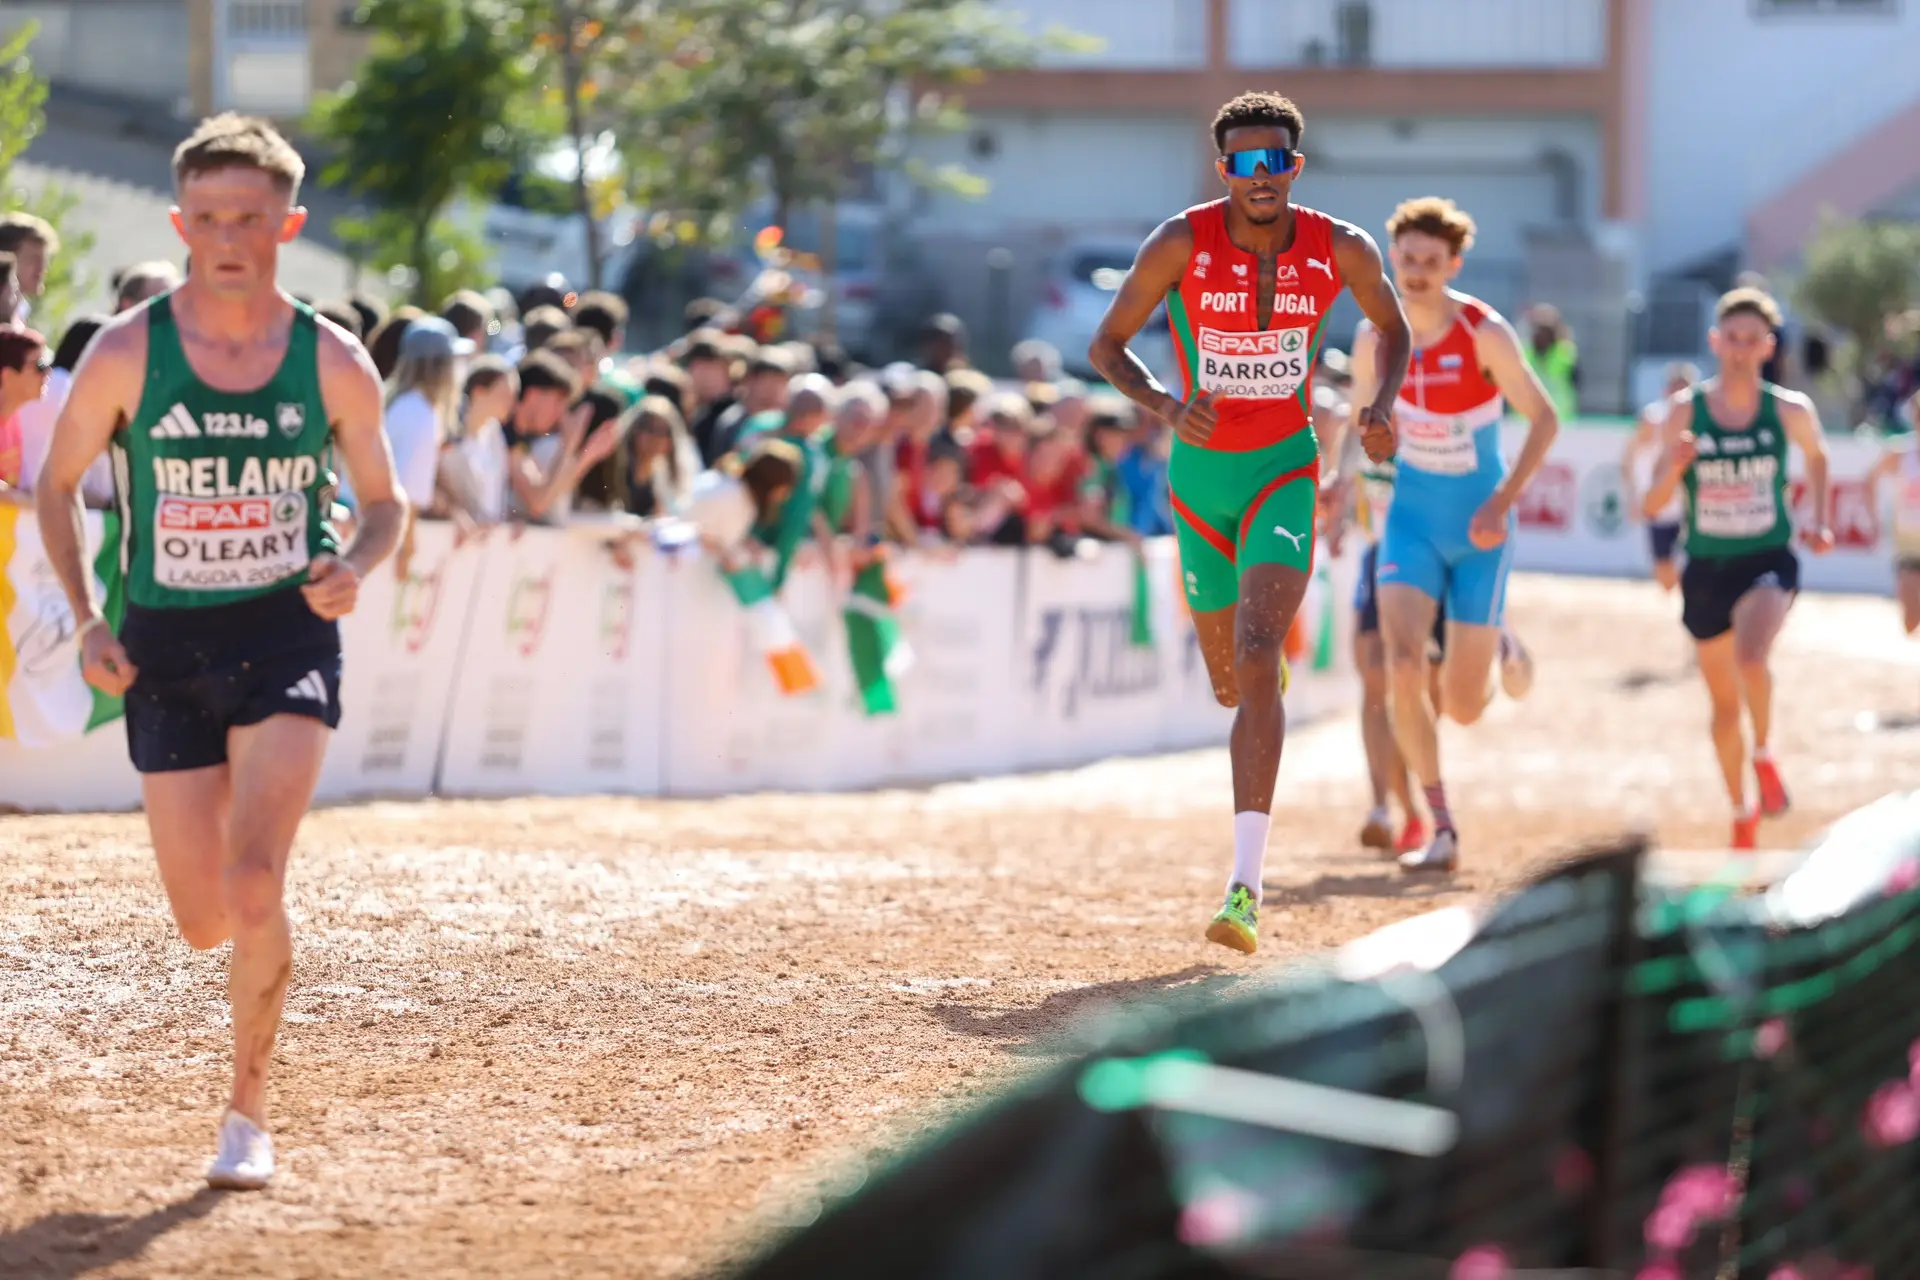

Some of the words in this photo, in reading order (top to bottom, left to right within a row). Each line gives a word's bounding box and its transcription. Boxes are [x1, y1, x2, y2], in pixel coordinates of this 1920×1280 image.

[1277, 264, 1299, 280] CA
[1200, 291, 1249, 313] PORT
[1273, 293, 1318, 316] UGAL
[1202, 333, 1277, 353] SPAR
[1205, 357, 1302, 380] BARROS
[1206, 381, 1258, 396] LAGOA
[1261, 383, 1298, 396] 2025
[202, 412, 270, 439] 123.ie
[152, 454, 318, 496] IRELAND
[162, 502, 269, 527] SPAR
[163, 528, 300, 562] O'LEARY
[168, 567, 241, 584] LAGOA
